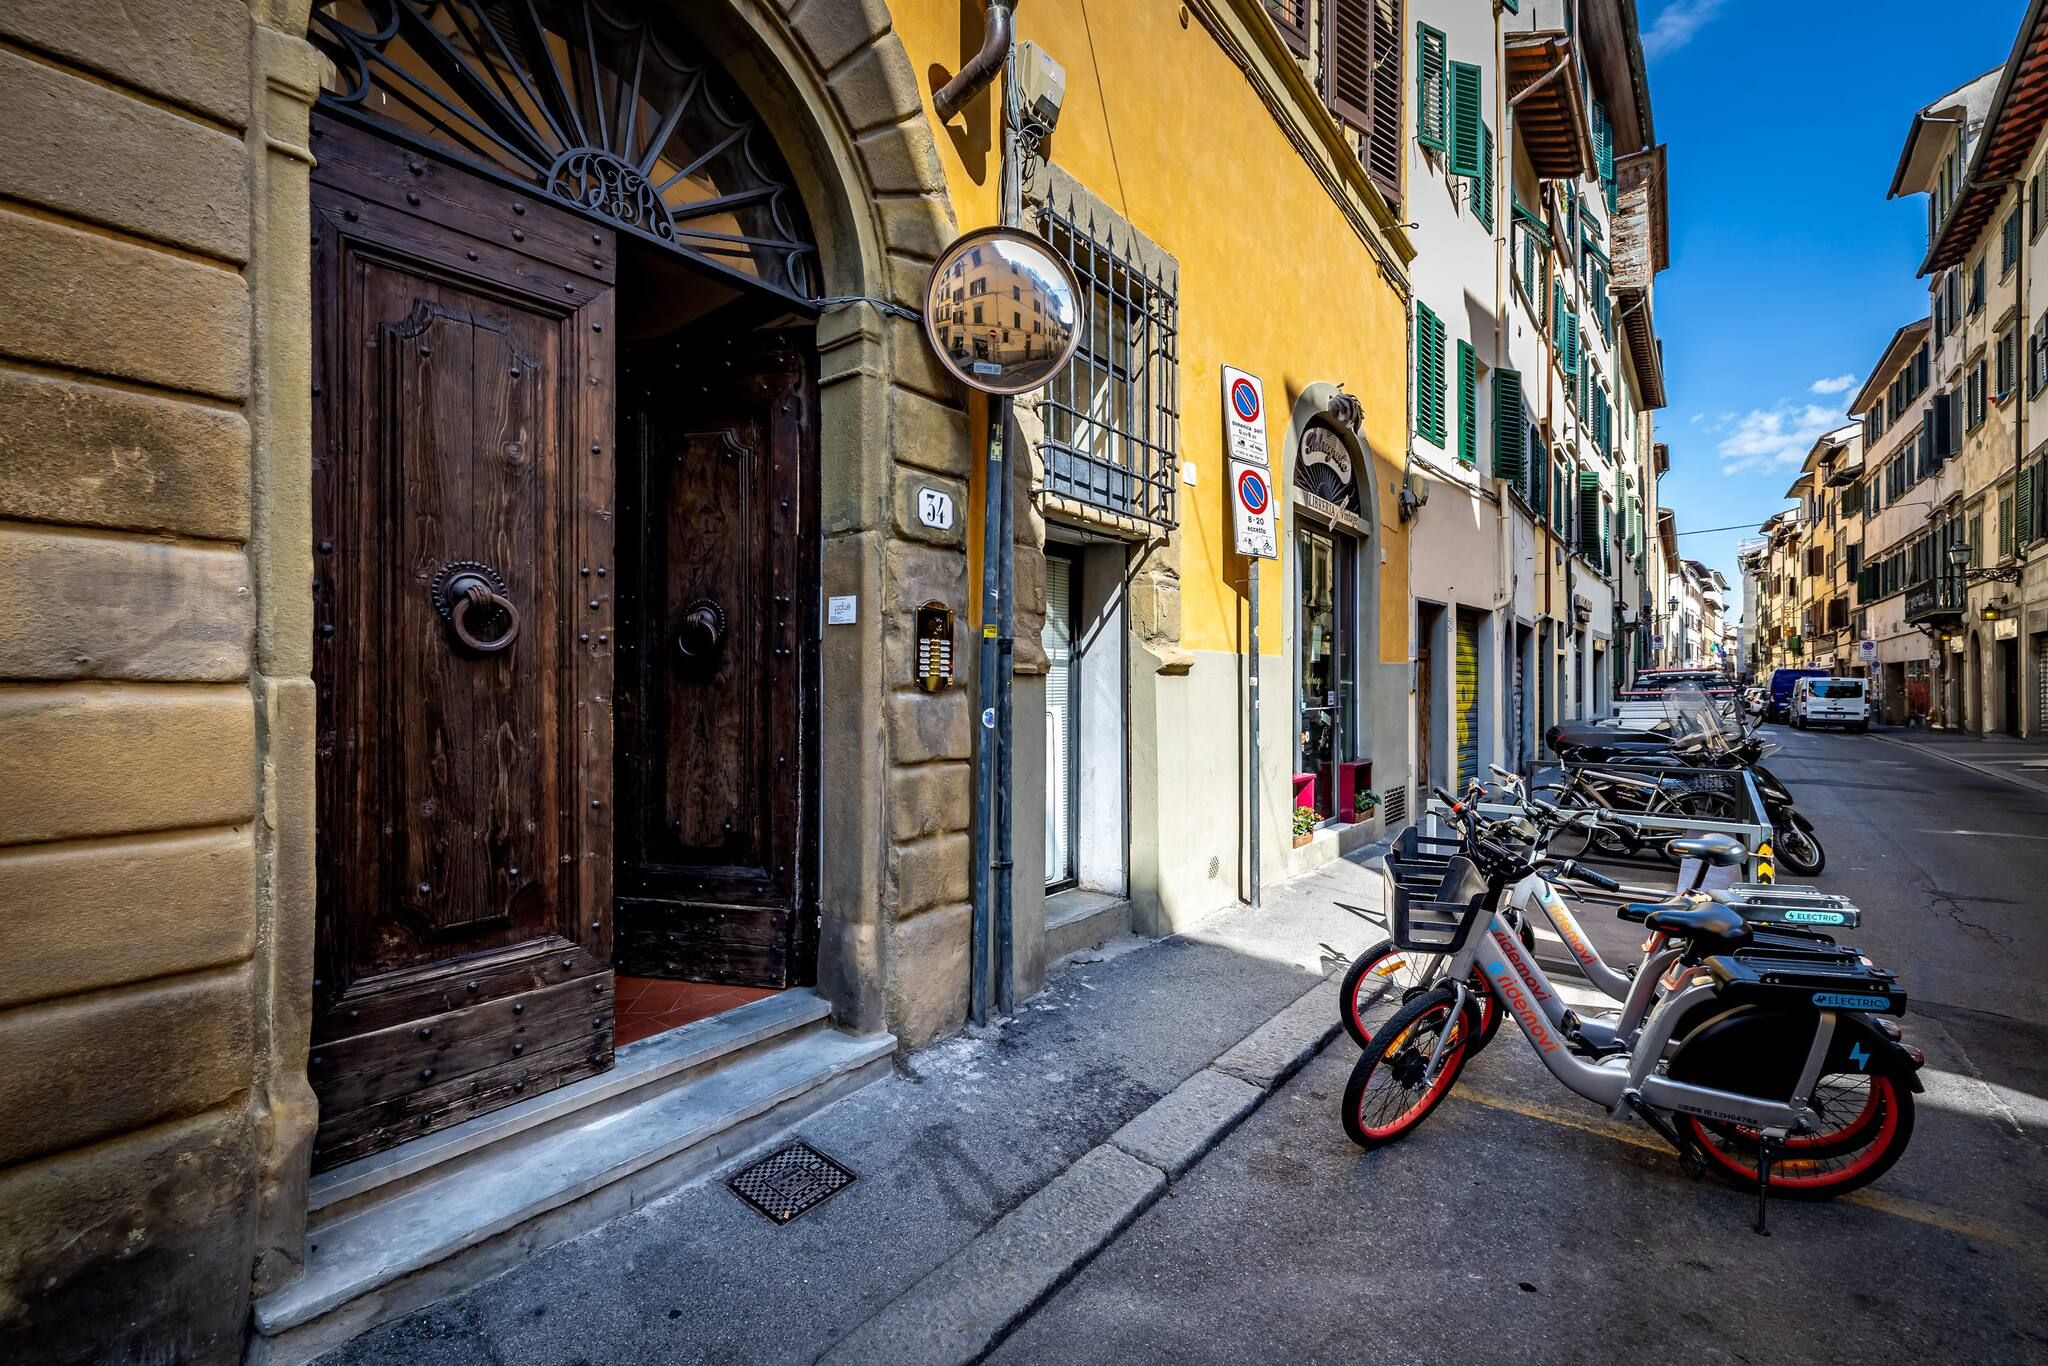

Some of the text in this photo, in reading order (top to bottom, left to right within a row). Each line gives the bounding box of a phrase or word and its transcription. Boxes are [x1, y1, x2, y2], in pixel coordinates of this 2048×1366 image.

[926, 493, 945, 524] 34
[1247, 526, 1267, 534] eccetto
[1797, 912, 1838, 922] ELECTRIC
[1547, 904, 1597, 966] ridemovi
[1494, 931, 1553, 1001] ridemovi
[1497, 975, 1563, 1054] ridemovi
[1828, 995, 1882, 1008] ELECTRIC
